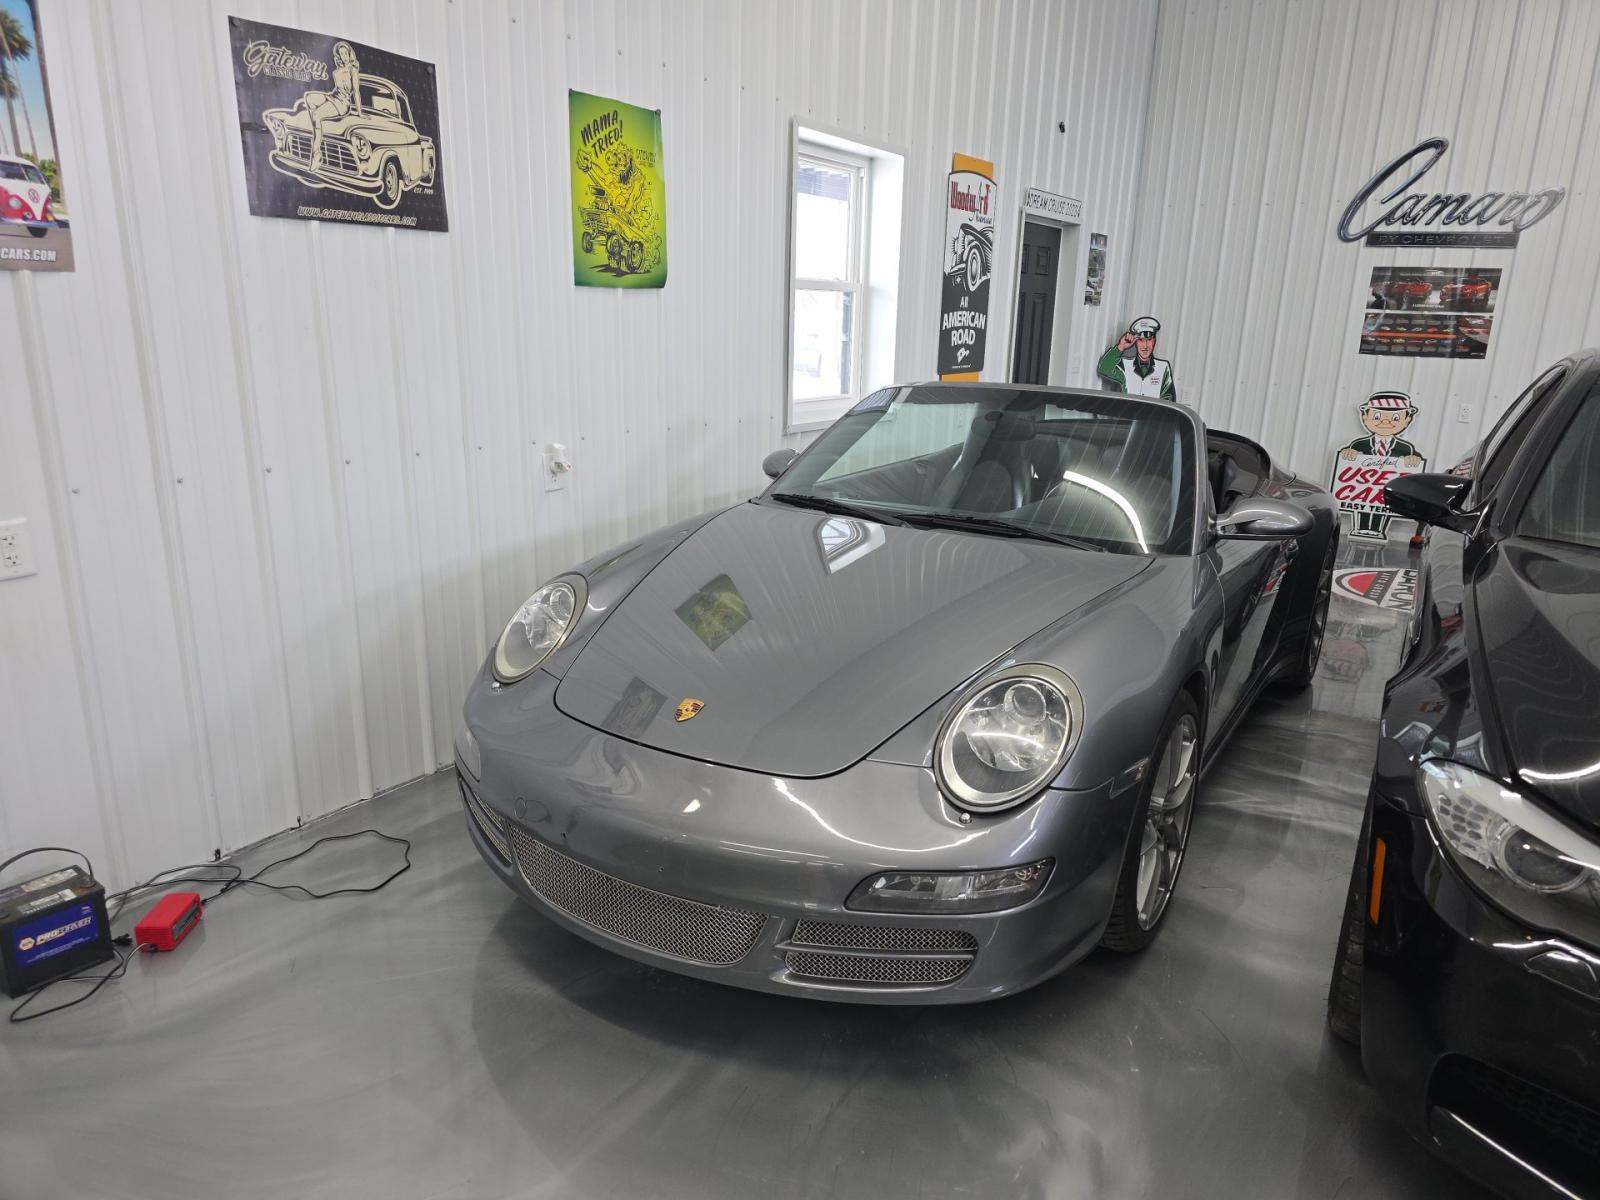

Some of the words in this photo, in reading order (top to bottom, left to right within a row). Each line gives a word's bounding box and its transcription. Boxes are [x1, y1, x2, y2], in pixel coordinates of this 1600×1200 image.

[244, 40, 329, 79] Gateway
[581, 110, 618, 146] MAMA
[592, 120, 623, 158] TRIED!
[1337, 136, 1565, 243] Camaro
[1379, 235, 1398, 244] BY
[1401, 235, 1505, 245] CHEVROLET
[942, 310, 986, 330] AMERICAN
[952, 329, 976, 346] ROAD
[1338, 466, 1410, 485] USE
[1341, 501, 1366, 511] EASY
